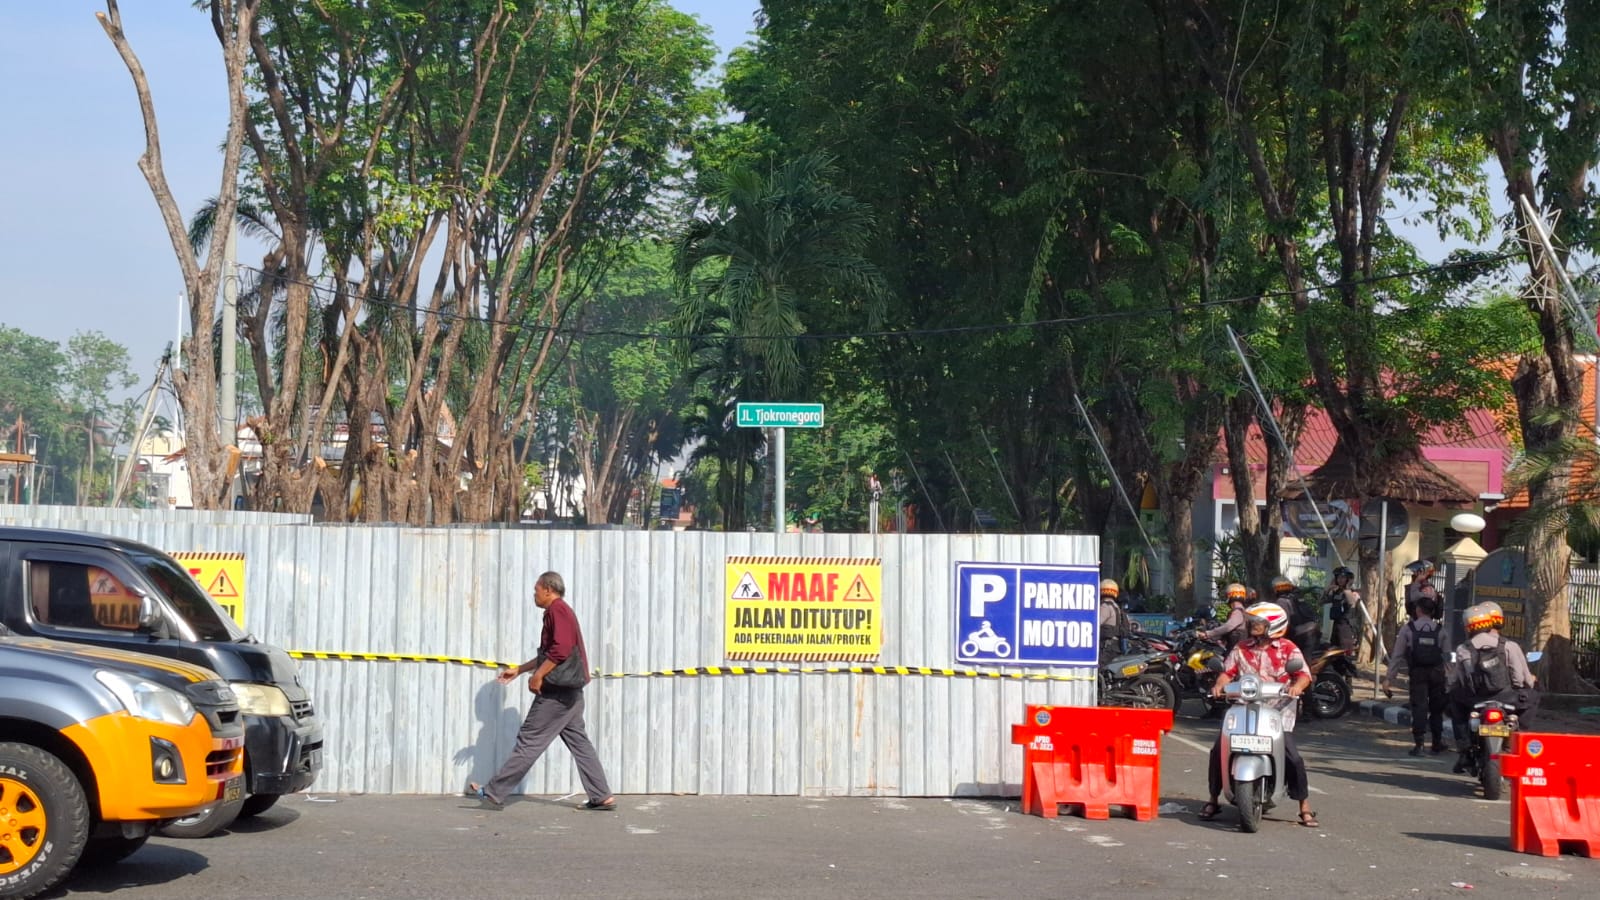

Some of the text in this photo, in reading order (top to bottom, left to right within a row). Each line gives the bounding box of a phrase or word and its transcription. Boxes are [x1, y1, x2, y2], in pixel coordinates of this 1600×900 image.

[755, 408, 820, 425] Tjokronegoro
[768, 572, 839, 602] MAAF
[970, 574, 1007, 617] P
[1024, 582, 1095, 611] PARKIR
[734, 607, 872, 630] JALAN DITUTUP!
[734, 633, 871, 645] ADA PEKERJAAN JALAN/PROYEK
[1023, 620, 1093, 648] MOTOR
